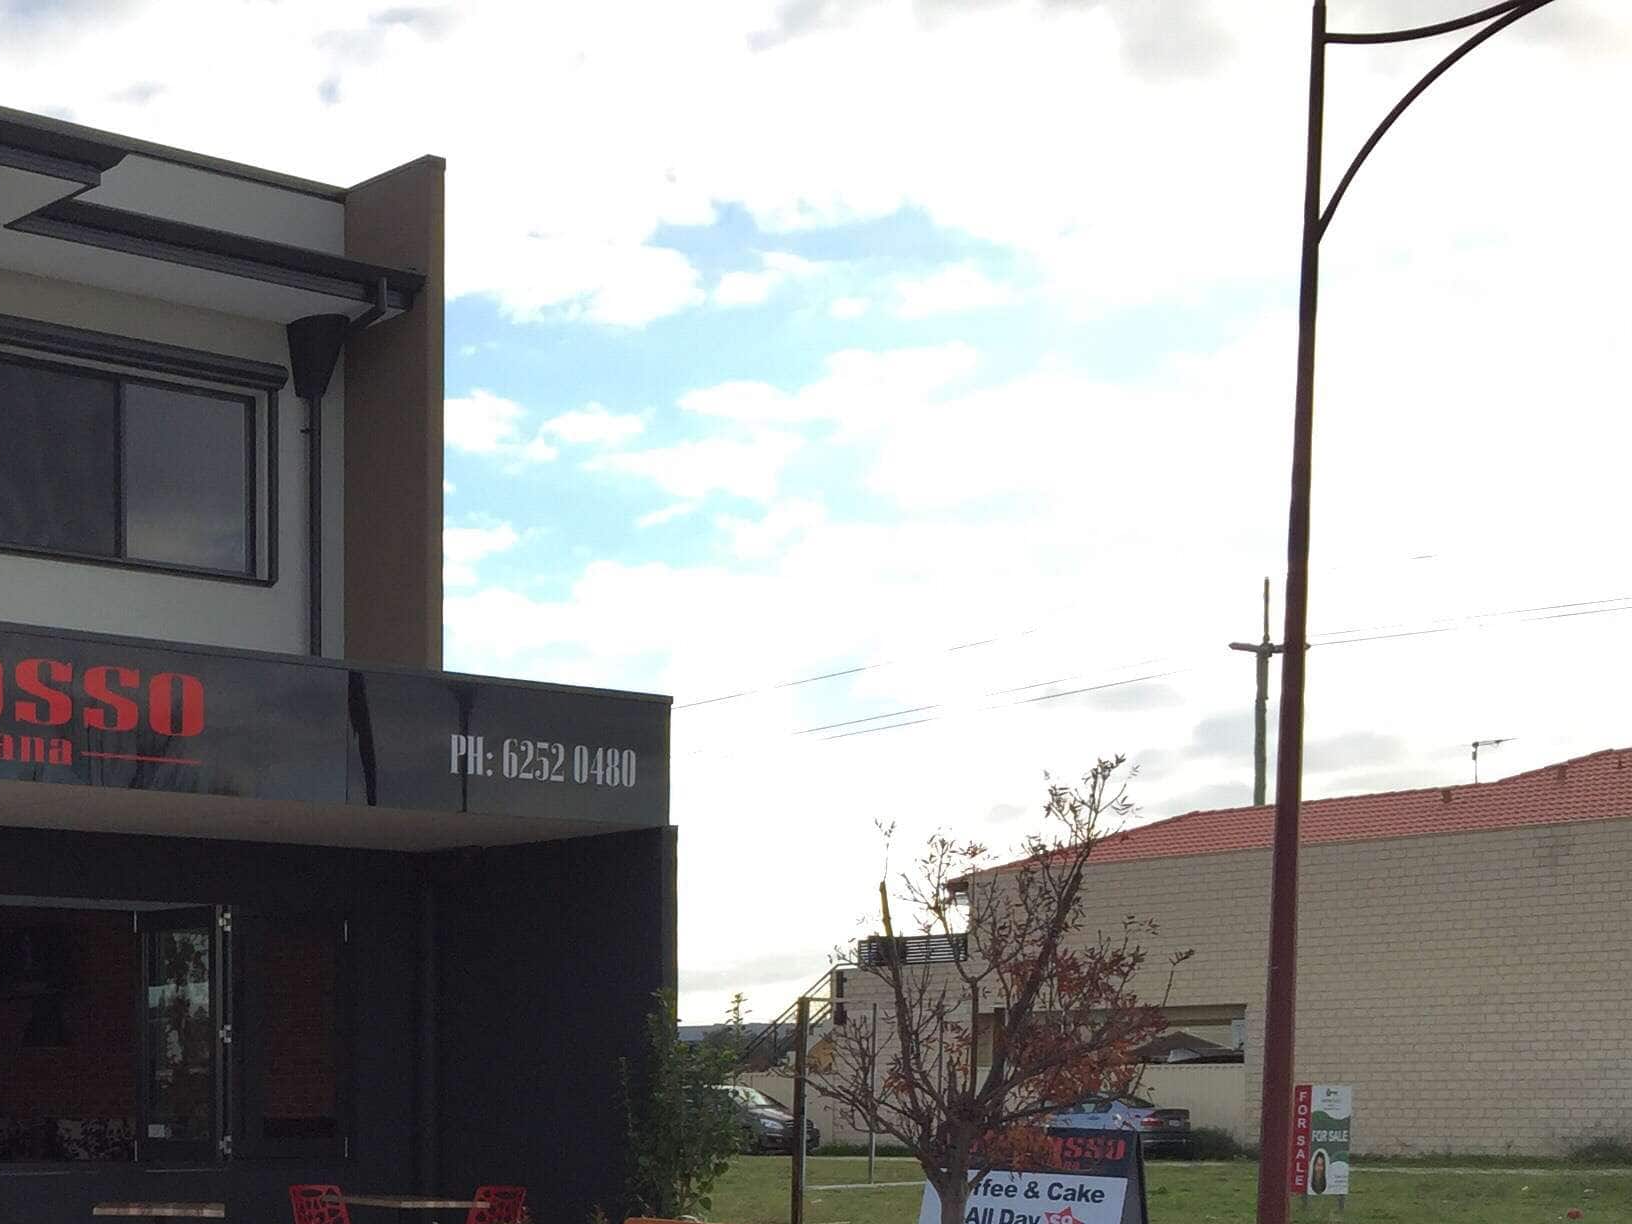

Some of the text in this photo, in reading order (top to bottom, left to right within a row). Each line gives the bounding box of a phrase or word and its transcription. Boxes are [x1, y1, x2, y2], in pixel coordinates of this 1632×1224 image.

[450, 733, 637, 788] PH: 6252 0480
[1297, 1091, 1308, 1129] FOR
[1312, 1130, 1348, 1142] FOR SALE
[1295, 1135, 1306, 1186] SALE
[973, 1179, 1105, 1204] ffee & Cake
